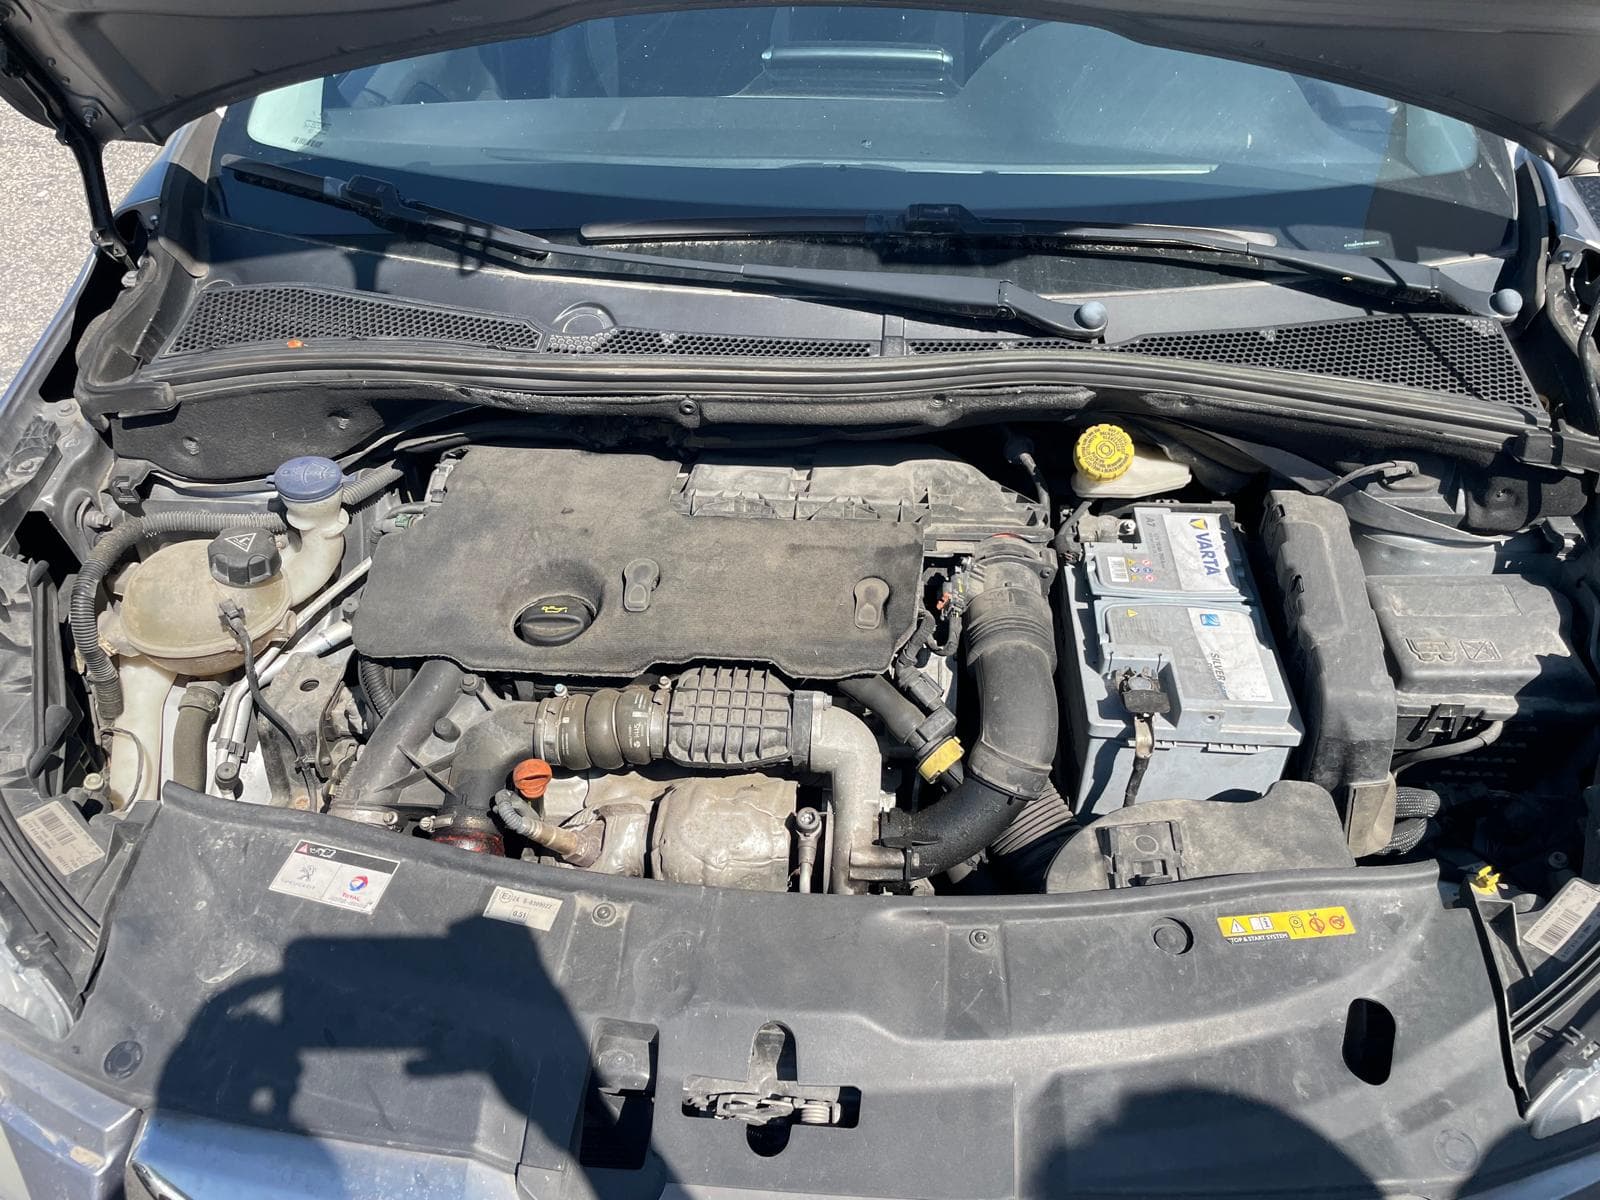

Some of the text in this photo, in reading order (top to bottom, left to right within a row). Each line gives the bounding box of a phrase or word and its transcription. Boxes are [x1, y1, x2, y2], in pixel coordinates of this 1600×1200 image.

[1196, 532, 1221, 576] VARTA
[1210, 652, 1226, 682] SILVER
[342, 892, 360, 902] TOTAL
[1227, 936, 1243, 944] TOP
